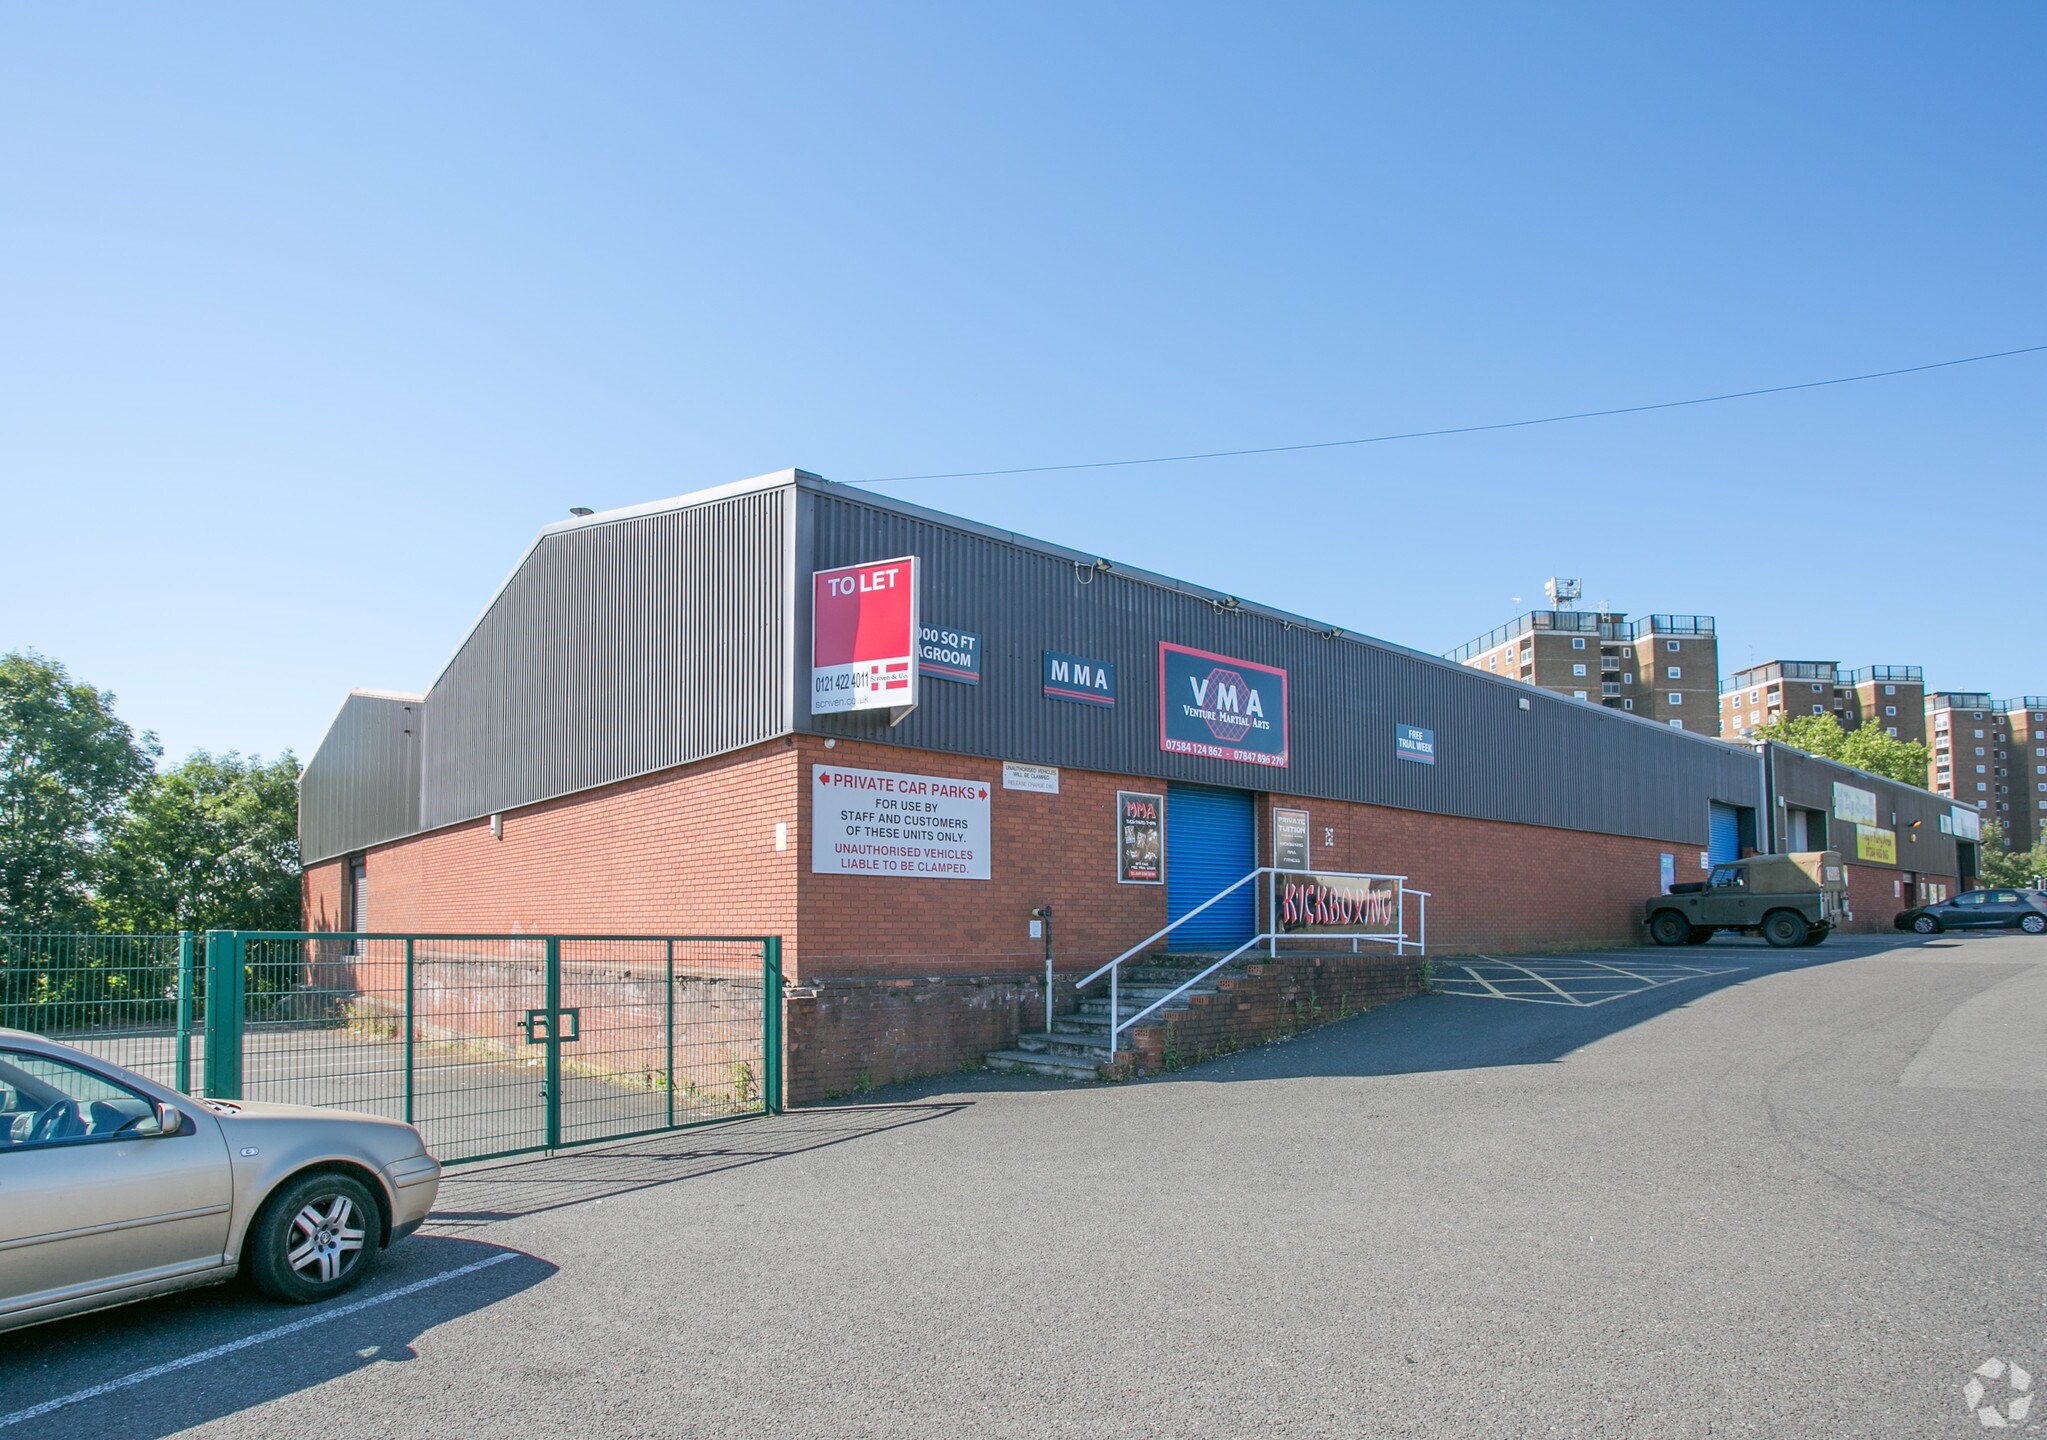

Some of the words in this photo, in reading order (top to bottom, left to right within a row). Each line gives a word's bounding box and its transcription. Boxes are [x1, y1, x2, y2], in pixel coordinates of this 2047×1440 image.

[828, 576, 855, 596] TO
[860, 568, 898, 592] LET
[941, 631, 958, 648] SQ
[961, 635, 975, 650] FT
[816, 675, 833, 692] 0121
[836, 674, 849, 690] 422
[851, 672, 868, 688] 4011
[870, 674, 890, 682] Scriven
[816, 696, 869, 708] scriven.co.uk
[1183, 705, 1216, 720] VENTURE
[1220, 712, 1249, 726] MARTIAL
[1252, 718, 1270, 730] ARTS
[1409, 729, 1423, 740] FREE
[1166, 740, 1191, 753] 07584
[1193, 744, 1207, 754] 124
[1208, 746, 1222, 756] 862
[1234, 750, 1255, 762] 07847
[1257, 754, 1270, 764] 896
[1272, 756, 1284, 766] 270
[1398, 738, 1416, 750] TRIAL
[1416, 741, 1432, 753] WEEK
[834, 774, 894, 792] PRIVATE
[898, 780, 927, 795] CAR
[931, 784, 975, 800] PARKS
[876, 798, 897, 810] FOR
[901, 801, 921, 811] USE
[925, 803, 938, 813] BY
[1126, 801, 1156, 819] MMA
[840, 811, 875, 823] STAFF
[879, 813, 901, 824] AND
[904, 815, 968, 829] CUSTOMERS
[1278, 816, 1305, 825] PRIVATE
[846, 825, 861, 836] OF
[864, 827, 899, 838] THESE
[903, 830, 933, 841] UNITS
[937, 832, 966, 843] ONLY.
[1278, 825, 1305, 834] TUITION
[835, 843, 920, 857] UNAUTHORISED
[924, 848, 973, 860] VEHICLES
[841, 858, 879, 869] LIABLE
[883, 860, 897, 870] TO
[900, 860, 914, 871] BE
[917, 861, 968, 874] CLAMPED.
[1283, 883, 1392, 926] KICKBOXING
